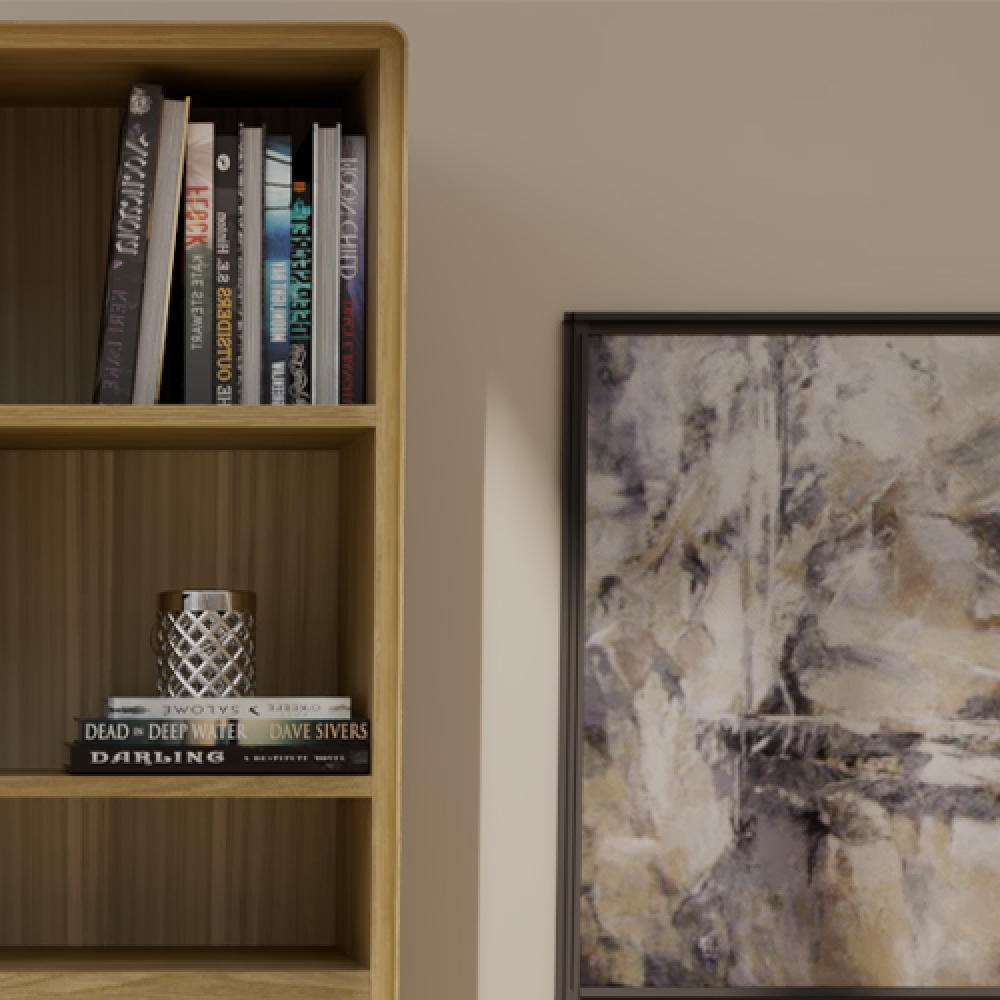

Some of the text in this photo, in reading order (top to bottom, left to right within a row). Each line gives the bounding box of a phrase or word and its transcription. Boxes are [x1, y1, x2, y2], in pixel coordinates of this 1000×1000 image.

[84, 722, 129, 741] DEAD
[149, 722, 188, 741] DEEP
[192, 722, 248, 741] WATER
[269, 722, 369, 741] DAVE SIVERS
[89, 751, 225, 767] DARLING
